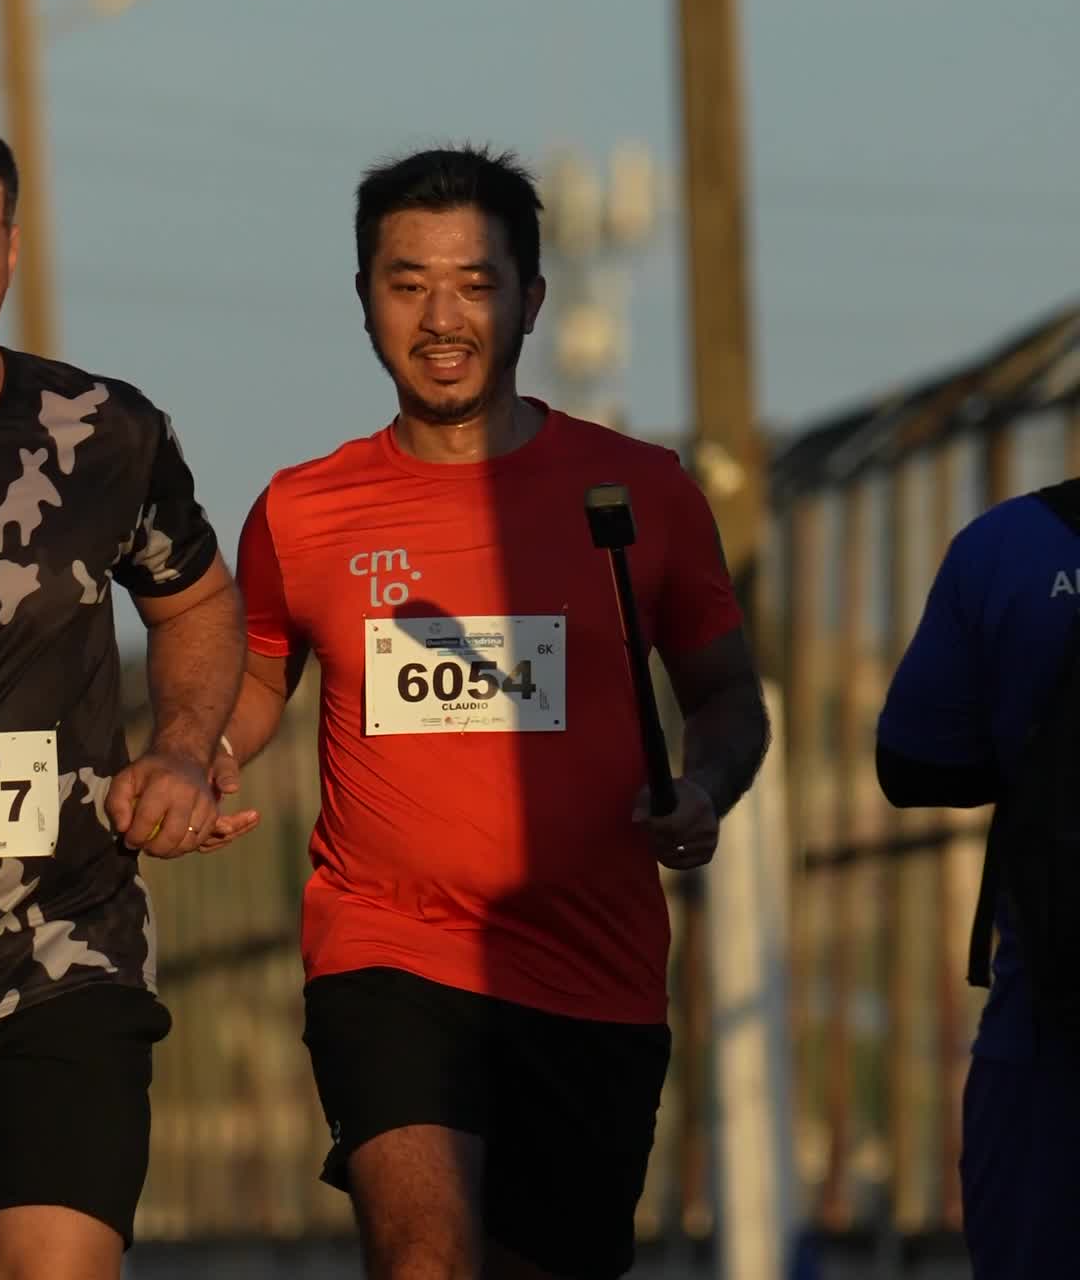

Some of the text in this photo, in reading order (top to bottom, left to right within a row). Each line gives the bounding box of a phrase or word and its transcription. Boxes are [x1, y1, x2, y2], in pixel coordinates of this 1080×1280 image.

[537, 644, 553, 654] 6K
[398, 660, 537, 702] 6054
[441, 702, 489, 711] CLAUDIO
[33, 761, 49, 772] 6K
